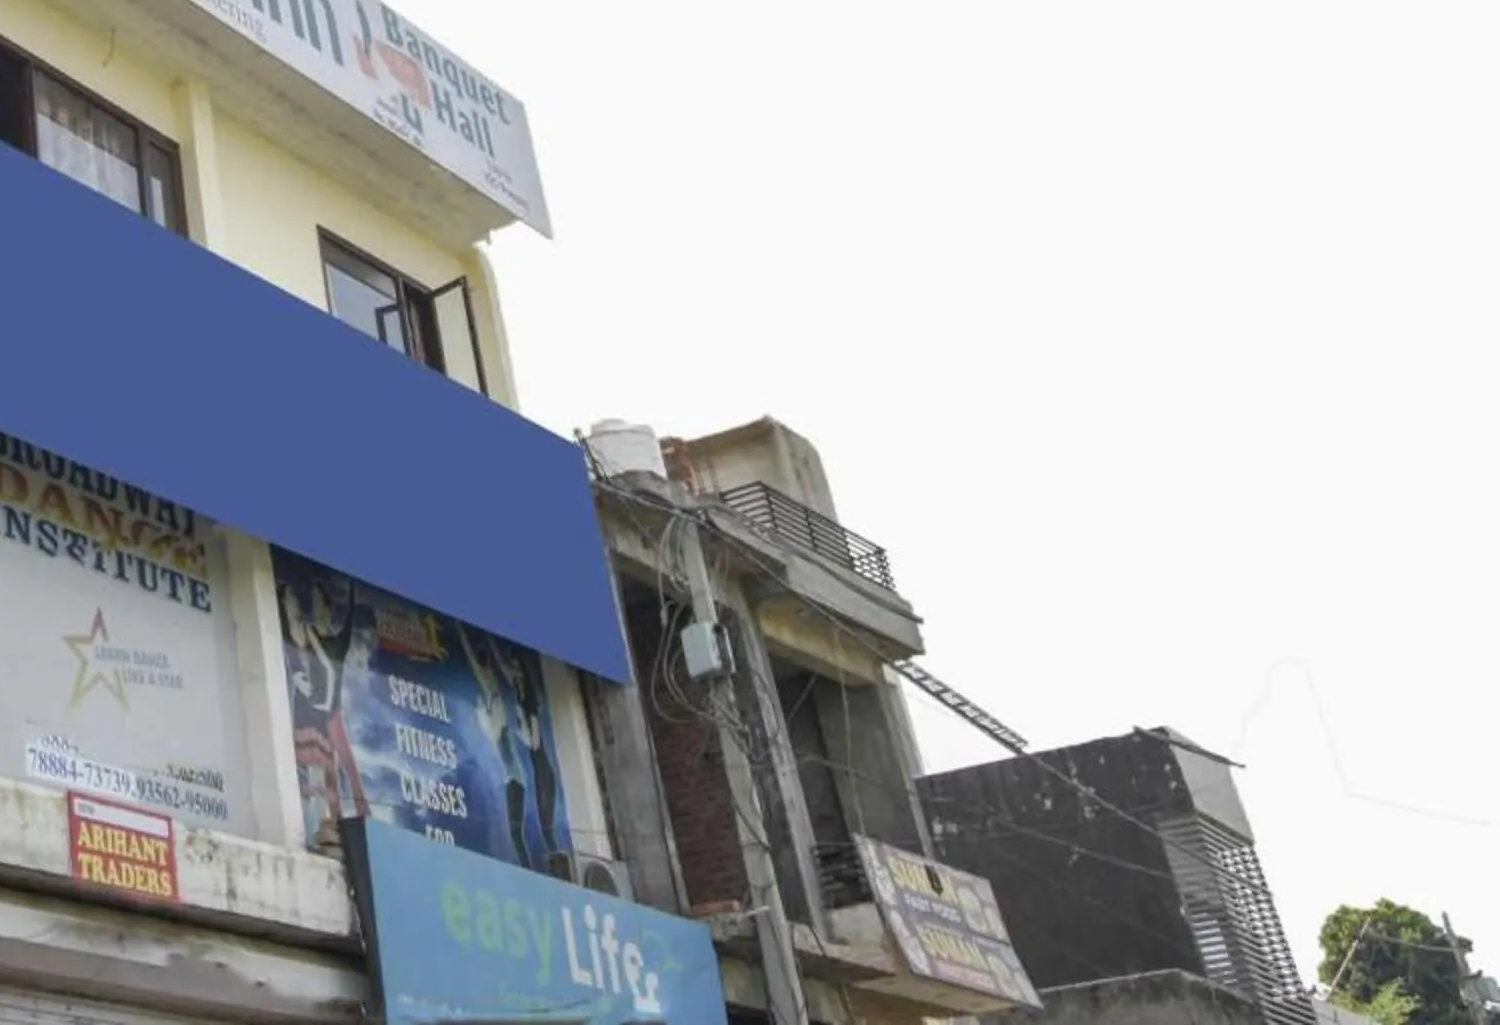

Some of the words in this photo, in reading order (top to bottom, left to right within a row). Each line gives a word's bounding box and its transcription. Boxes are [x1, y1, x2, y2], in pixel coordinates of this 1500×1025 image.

[380, 4, 512, 125] Banquet
[430, 80, 495, 159] Hall
[388, 674, 451, 724] SPECIAL
[395, 722, 458, 770] FITNESS
[400, 773, 468, 819] CLASSES
[76, 820, 170, 867] ARIHANT
[76, 851, 173, 897] TRADERS
